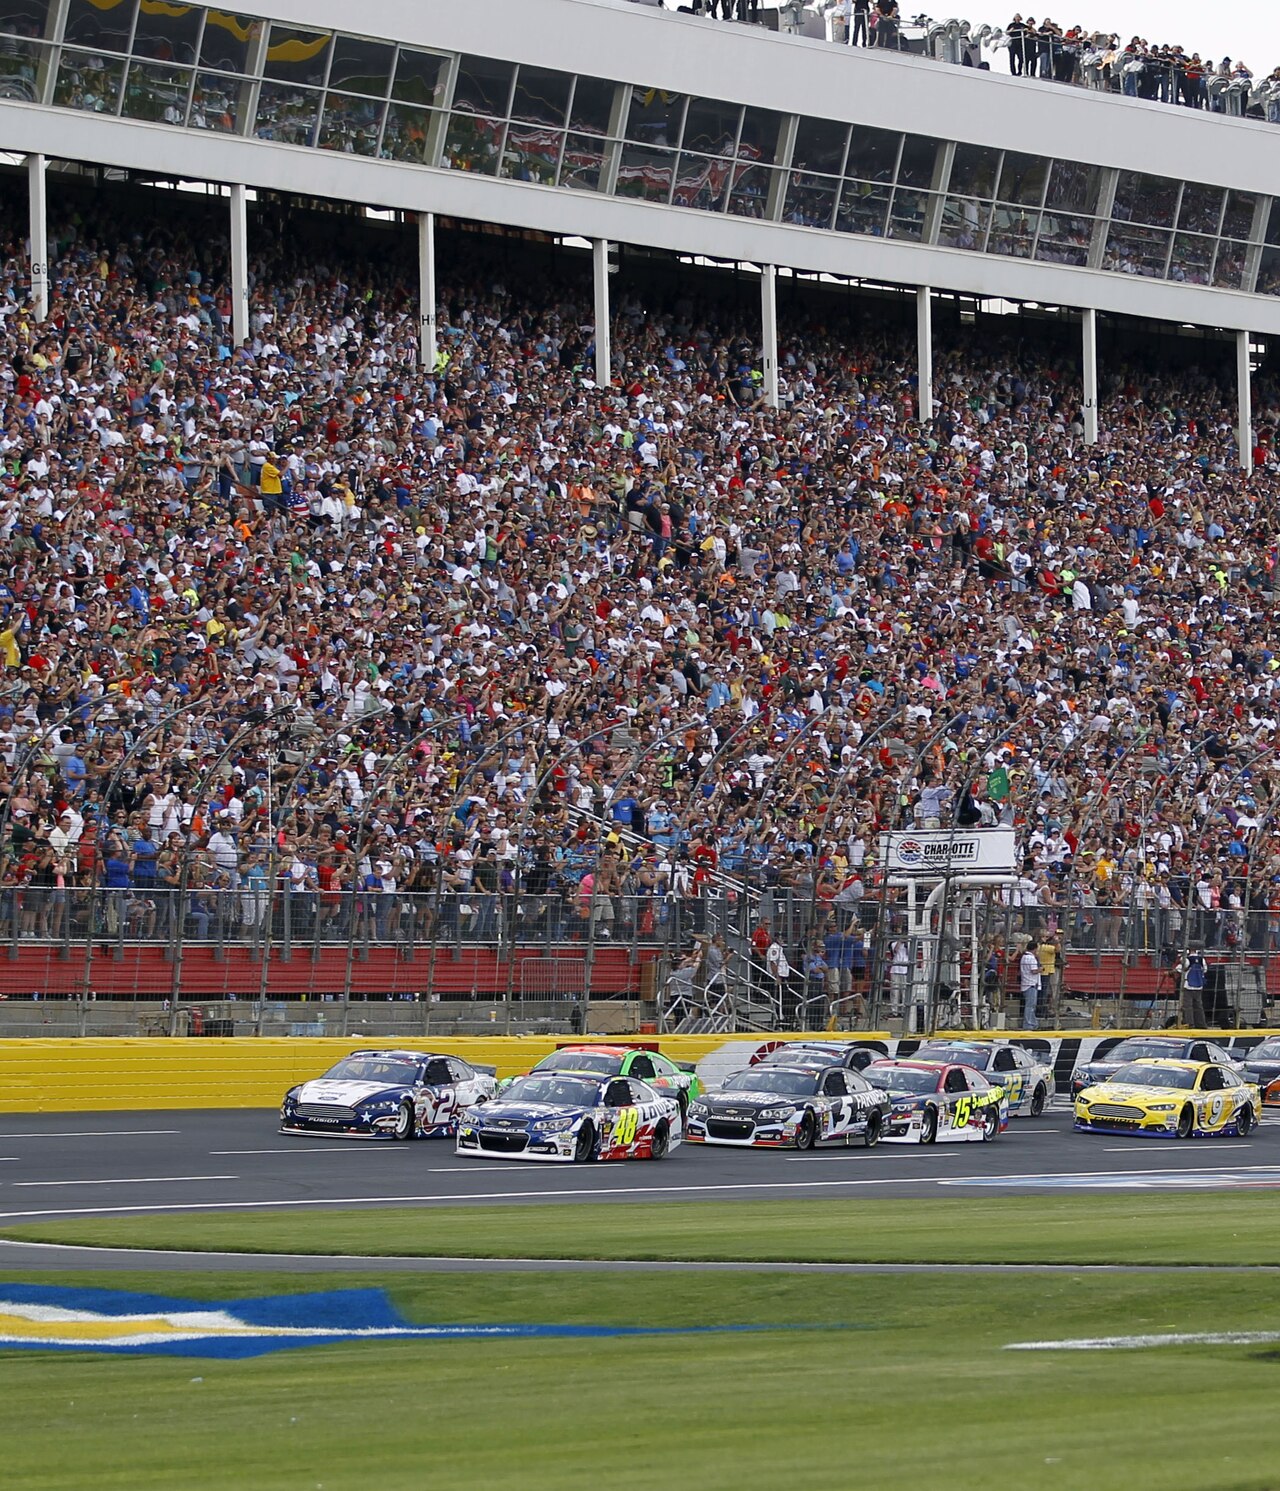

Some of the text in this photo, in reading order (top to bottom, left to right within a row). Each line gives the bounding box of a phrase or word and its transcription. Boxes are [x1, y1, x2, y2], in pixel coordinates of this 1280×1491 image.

[32, 263, 41, 274] G
[422, 315, 429, 325] H
[1085, 399, 1091, 408] J
[924, 842, 974, 855] CHAROTTE
[1004, 1072, 1023, 1102] 22
[434, 1088, 455, 1123] 2
[834, 1096, 854, 1133] 5
[951, 1097, 971, 1130] 15
[1208, 1094, 1224, 1126] 9
[614, 1107, 638, 1146] 48
